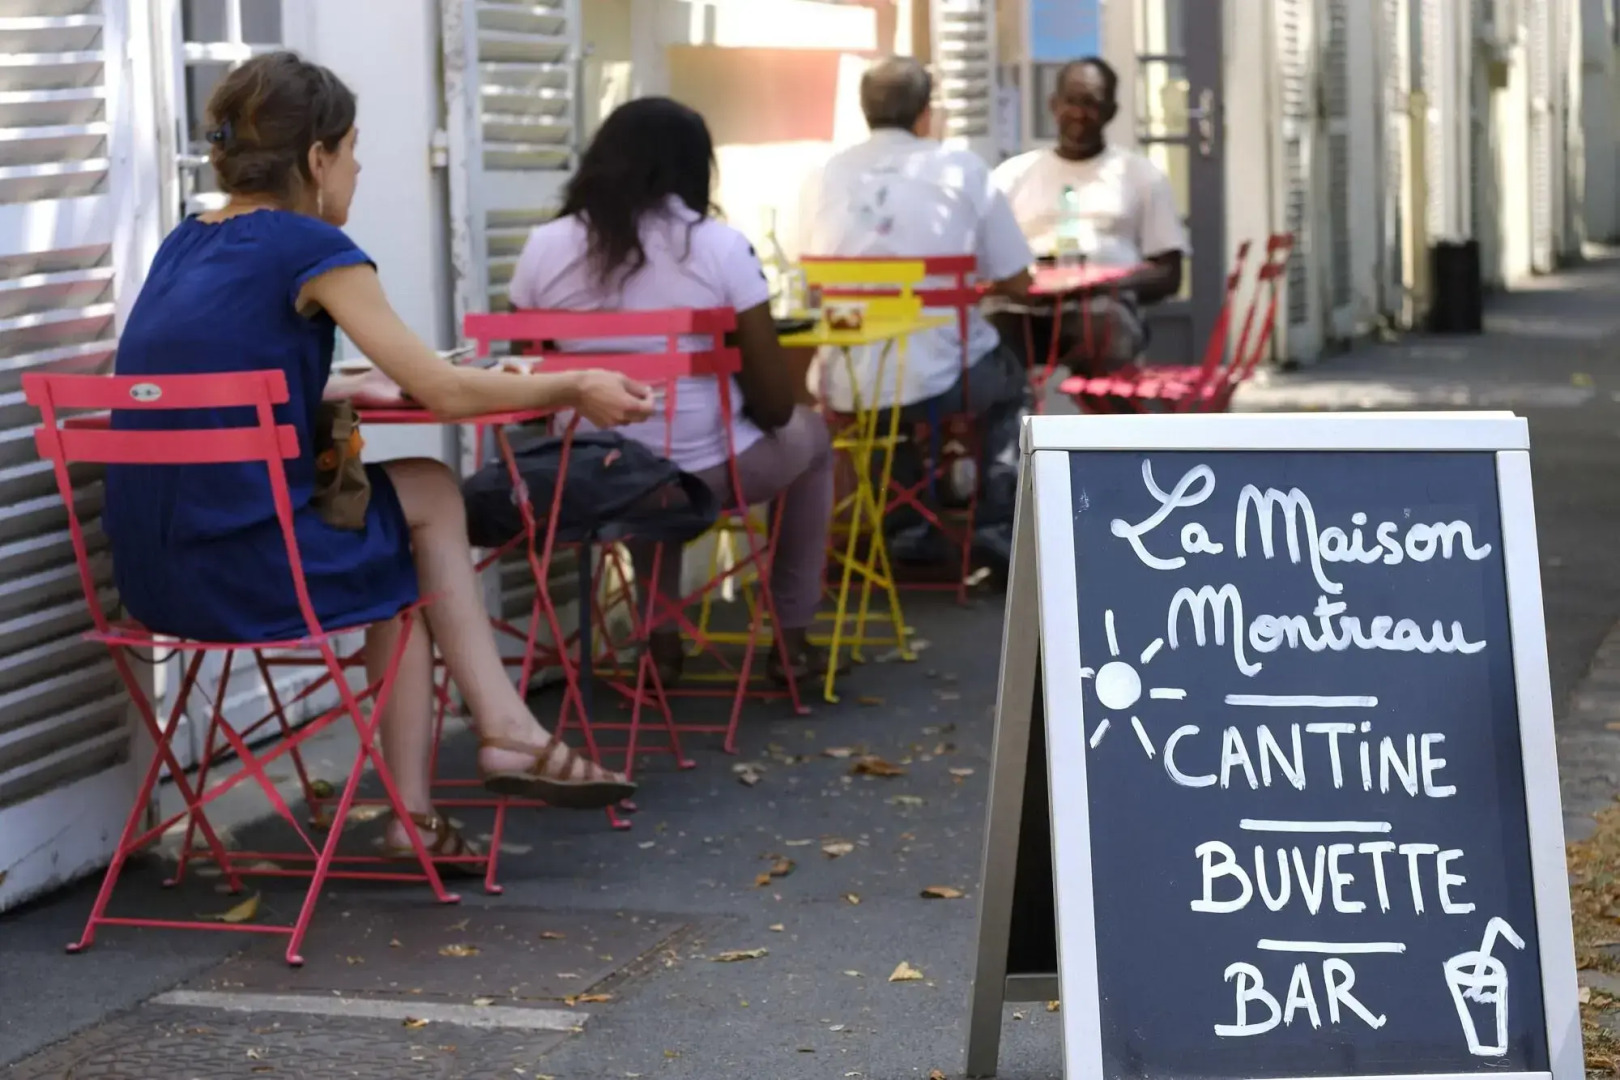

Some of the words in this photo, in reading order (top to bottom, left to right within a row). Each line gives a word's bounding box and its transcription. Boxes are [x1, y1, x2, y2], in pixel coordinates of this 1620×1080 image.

[1110, 458, 1224, 571] La
[1235, 483, 1492, 595] Maison
[1167, 583, 1487, 678] Montreau
[1190, 840, 1476, 916] BUVETTE
[1213, 957, 1387, 1037] BAR
